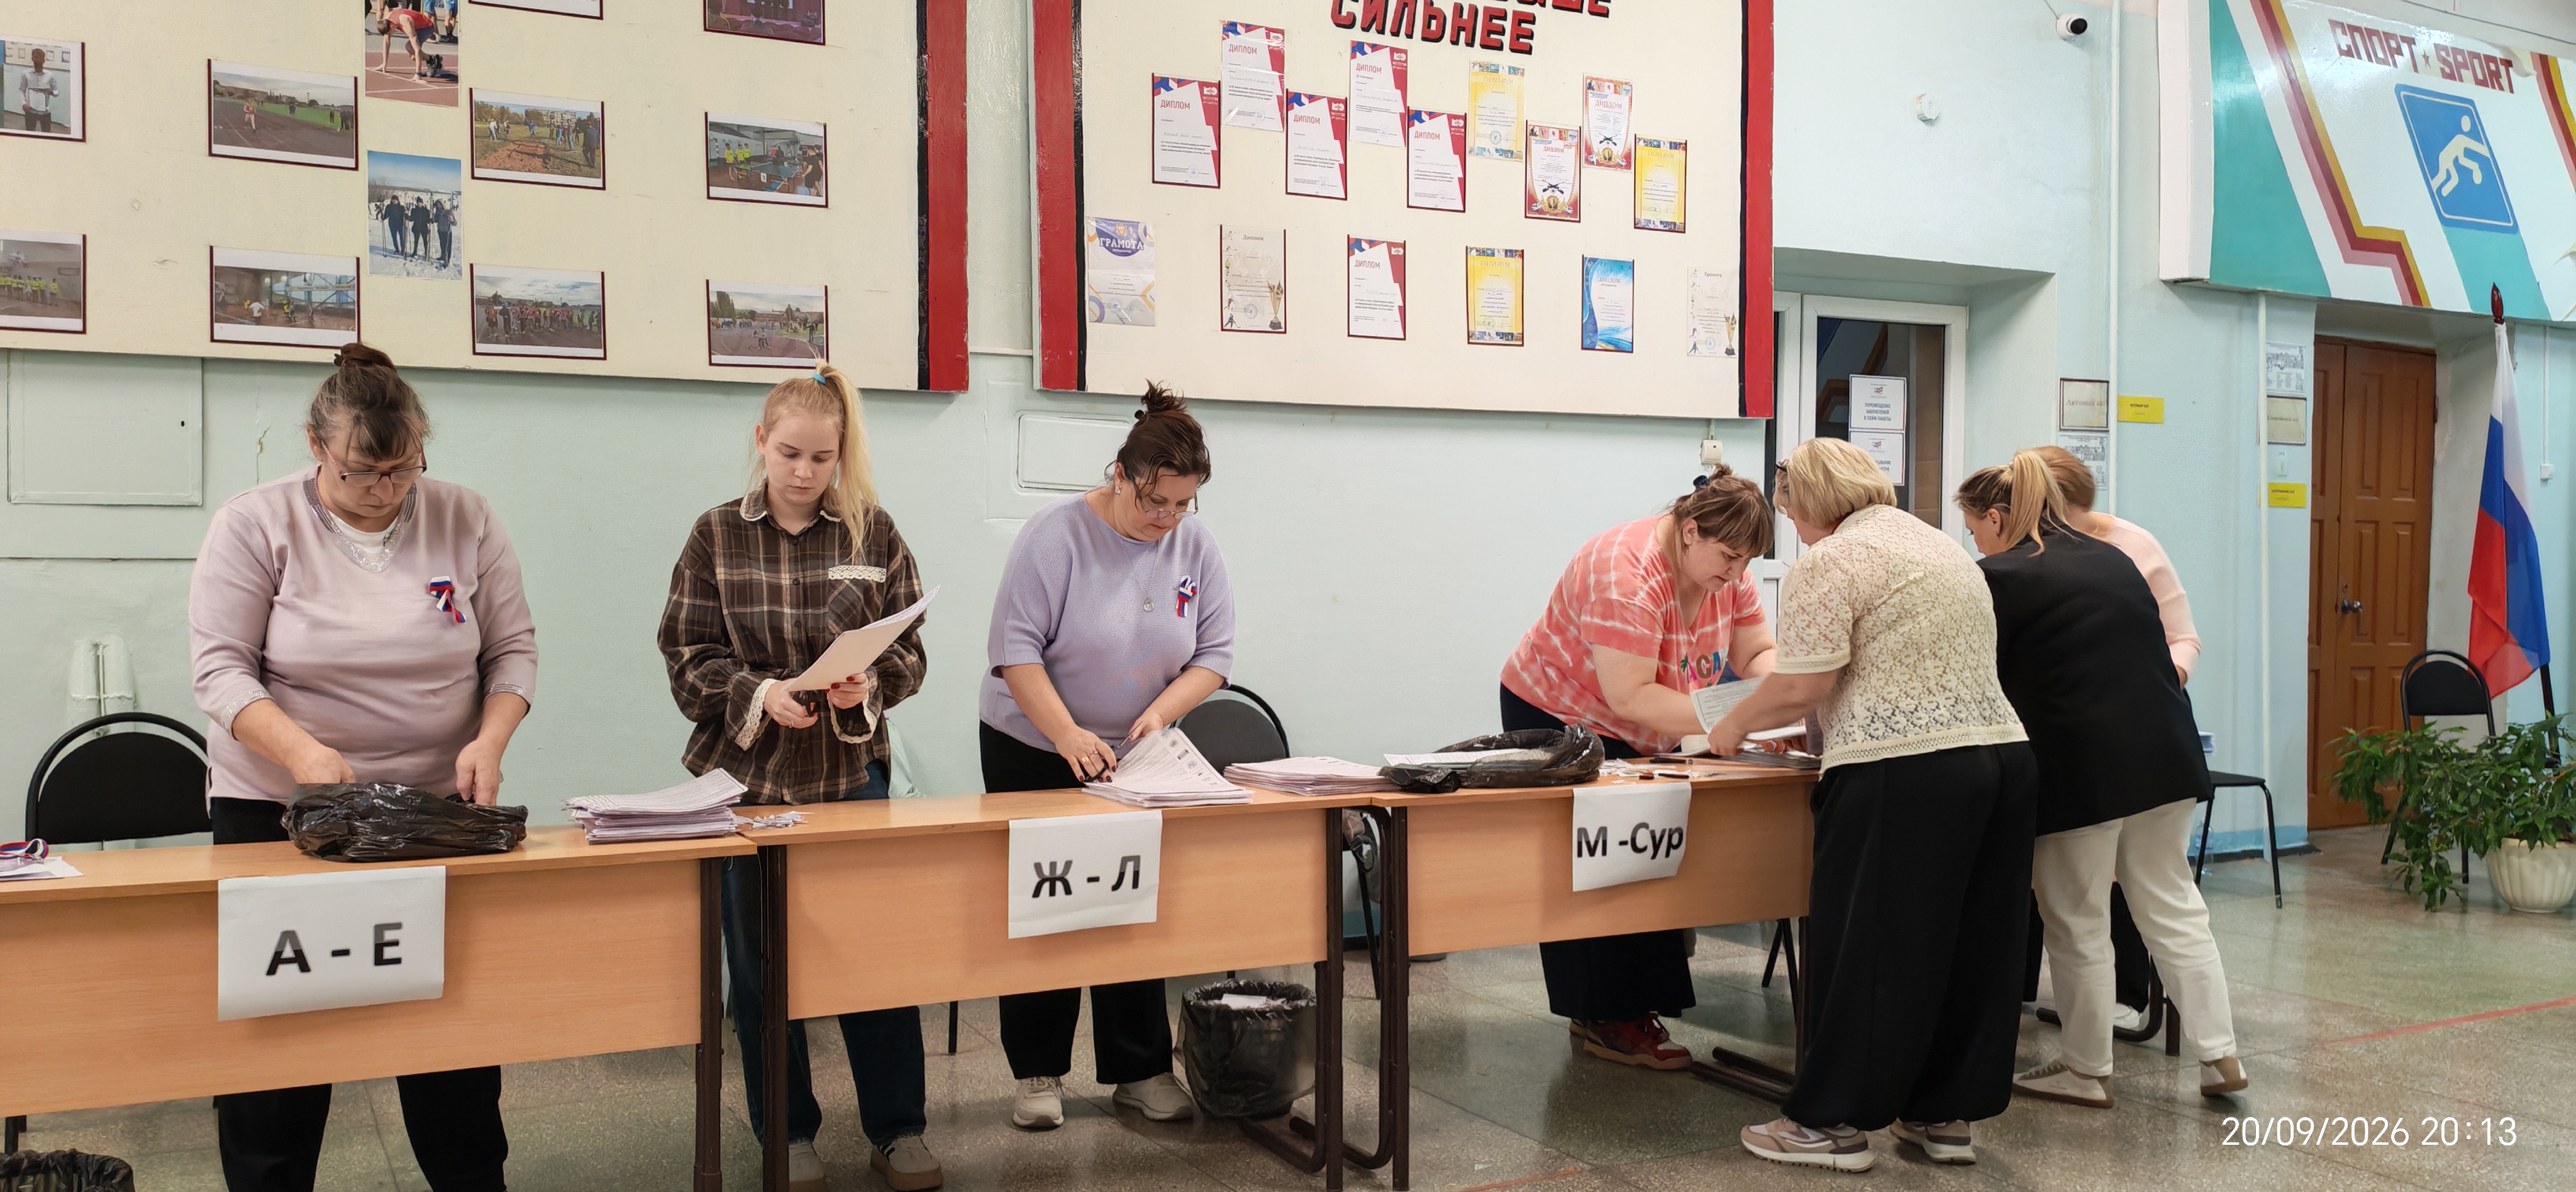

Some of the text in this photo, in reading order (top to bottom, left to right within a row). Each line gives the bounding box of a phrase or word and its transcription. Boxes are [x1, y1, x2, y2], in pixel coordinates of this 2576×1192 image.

[1331, 0, 1536, 55] СИЛЬНЕЕ
[1228, 43, 1257, 55] ДИПЛОМ
[2328, 19, 2419, 74] СПОРТ
[1356, 63, 1382, 74] ДИПЛОМ
[2433, 43, 2514, 94] SPORT
[1160, 99, 1191, 110] ДИПЛОМ
[1293, 114, 1320, 124] ДИПЛОМ
[1414, 130, 1440, 140] ДИПЛОМ
[1099, 237, 1144, 251] ГРАМОТА
[1354, 259, 1380, 269] ДИПЛОМ
[1577, 825, 1607, 858] М
[1031, 859, 1073, 899] Ж
[1111, 855, 1141, 892] Л
[265, 922, 402, 976] А - Е
